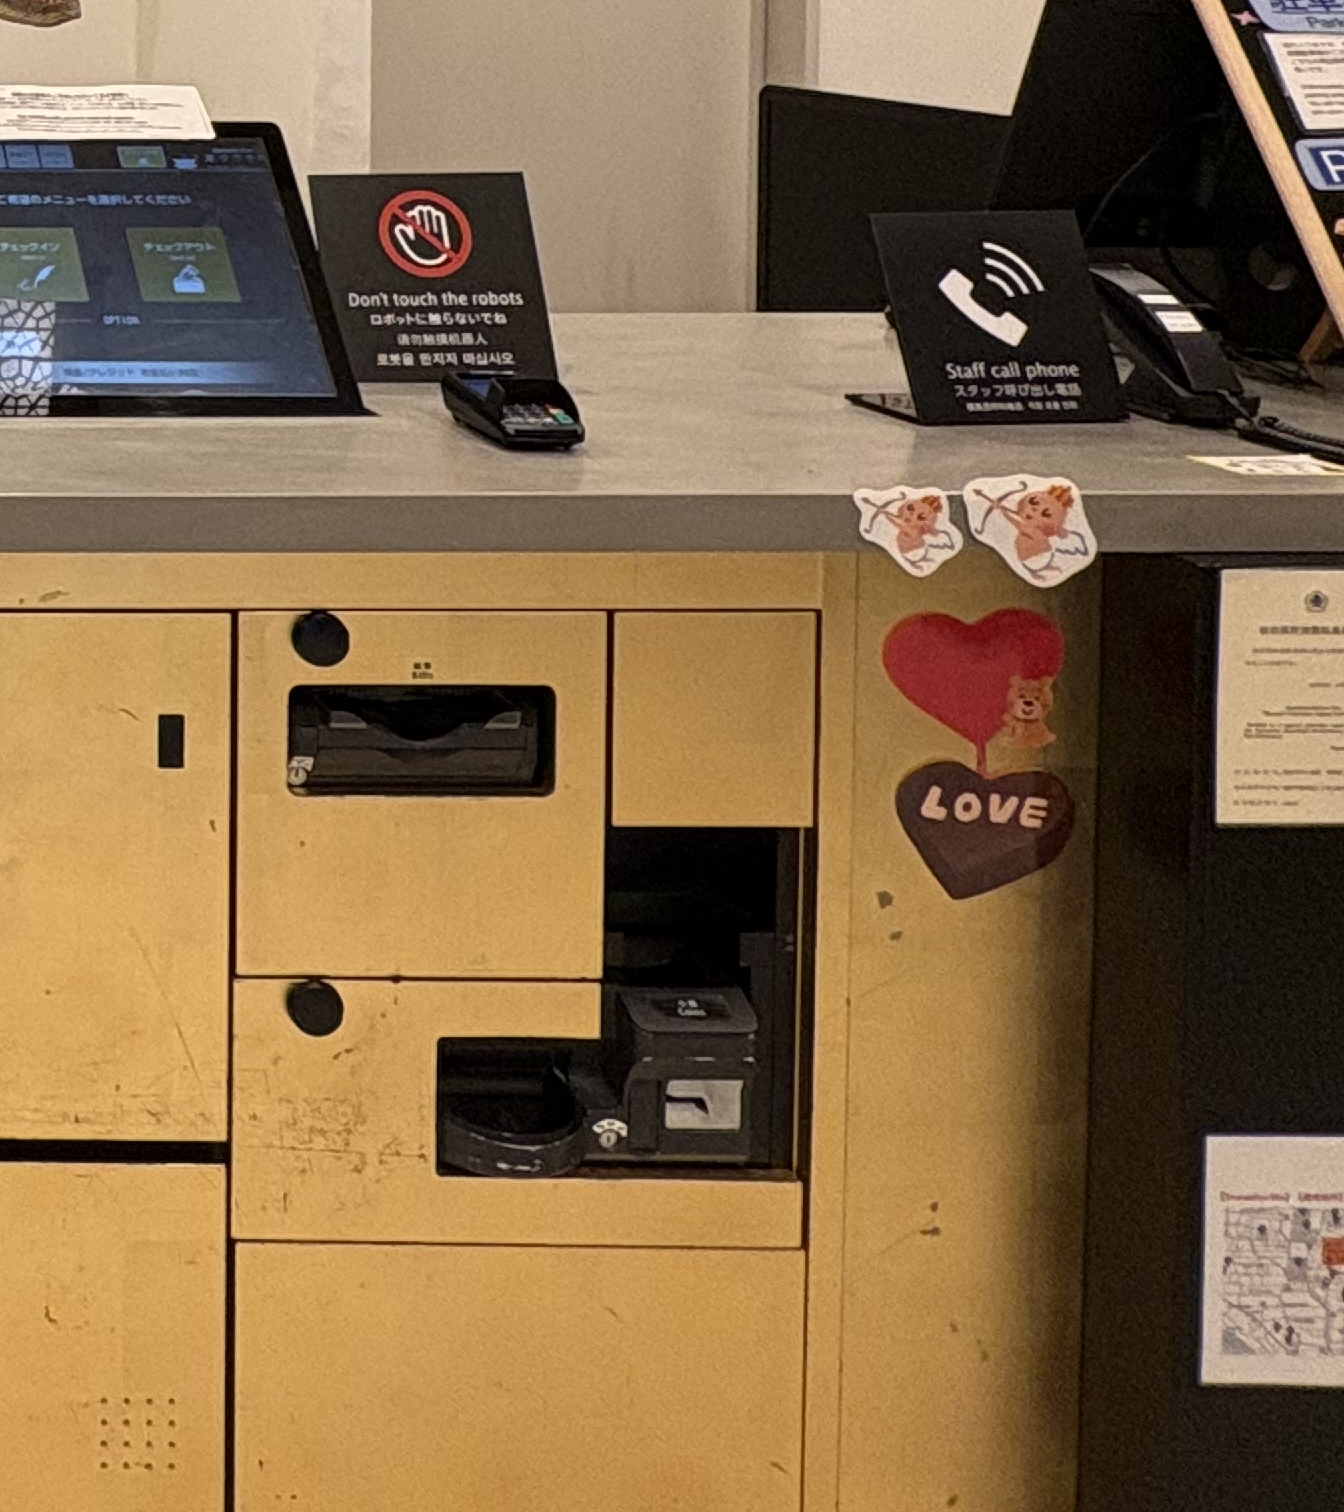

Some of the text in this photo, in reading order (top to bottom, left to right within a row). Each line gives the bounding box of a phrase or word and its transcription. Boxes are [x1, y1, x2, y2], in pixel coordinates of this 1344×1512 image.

[348, 290, 525, 308] Don't touch the robots
[369, 311, 508, 326] ロボットに触らないでね
[944, 360, 1081, 382] Staff call phone
[920, 785, 1049, 829] LOVE
